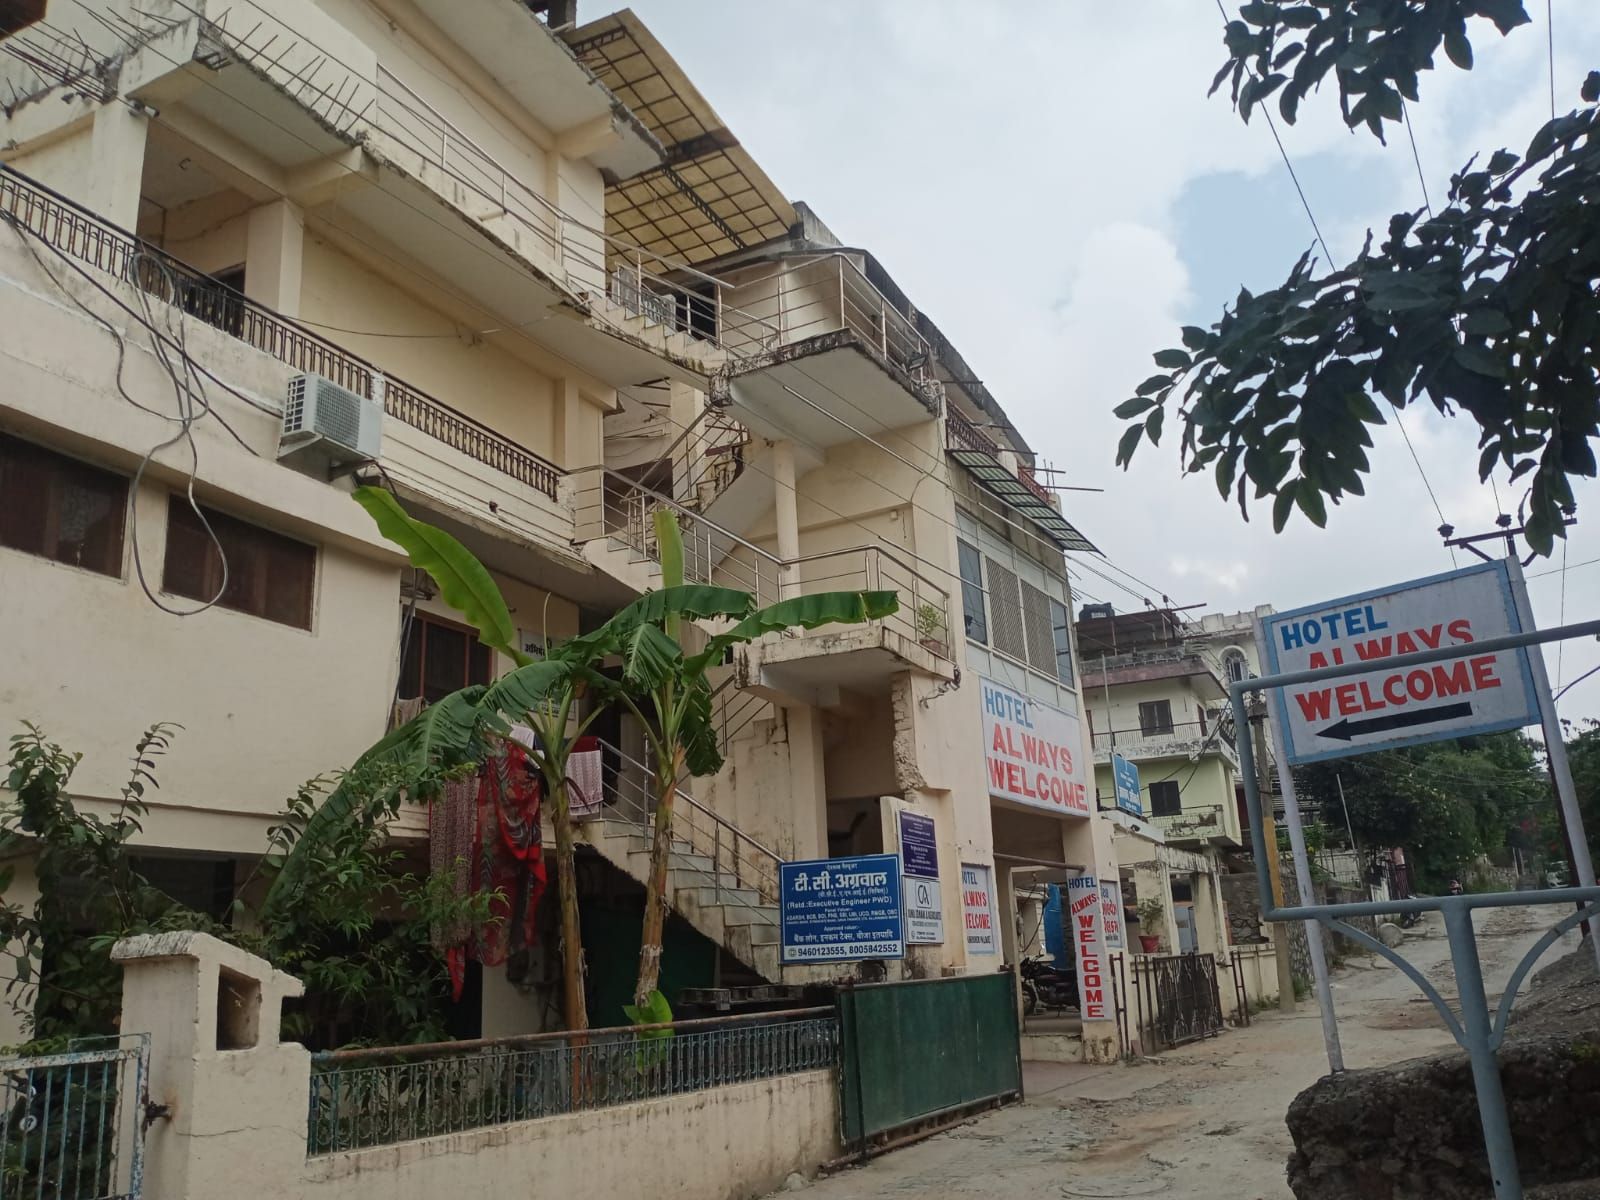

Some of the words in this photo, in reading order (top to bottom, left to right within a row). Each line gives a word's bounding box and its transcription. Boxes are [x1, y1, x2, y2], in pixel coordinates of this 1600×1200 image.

[1281, 605, 1388, 651] HOTEL
[984, 686, 1034, 729] HOTEL
[1295, 655, 1501, 722] WELCOME
[993, 723, 1073, 775] ALWAYS
[988, 756, 1088, 812] WELCOME
[962, 871, 978, 885] OTEL
[1068, 877, 1097, 889] HOTEL
[841, 897, 871, 906] Engineer
[872, 895, 892, 904] PWD)
[1071, 893, 1097, 916] ALWAYS
[798, 946, 847, 957] 9460123555,
[849, 943, 898, 954] 8005842552
[1078, 915, 1104, 1018] WELCOME
